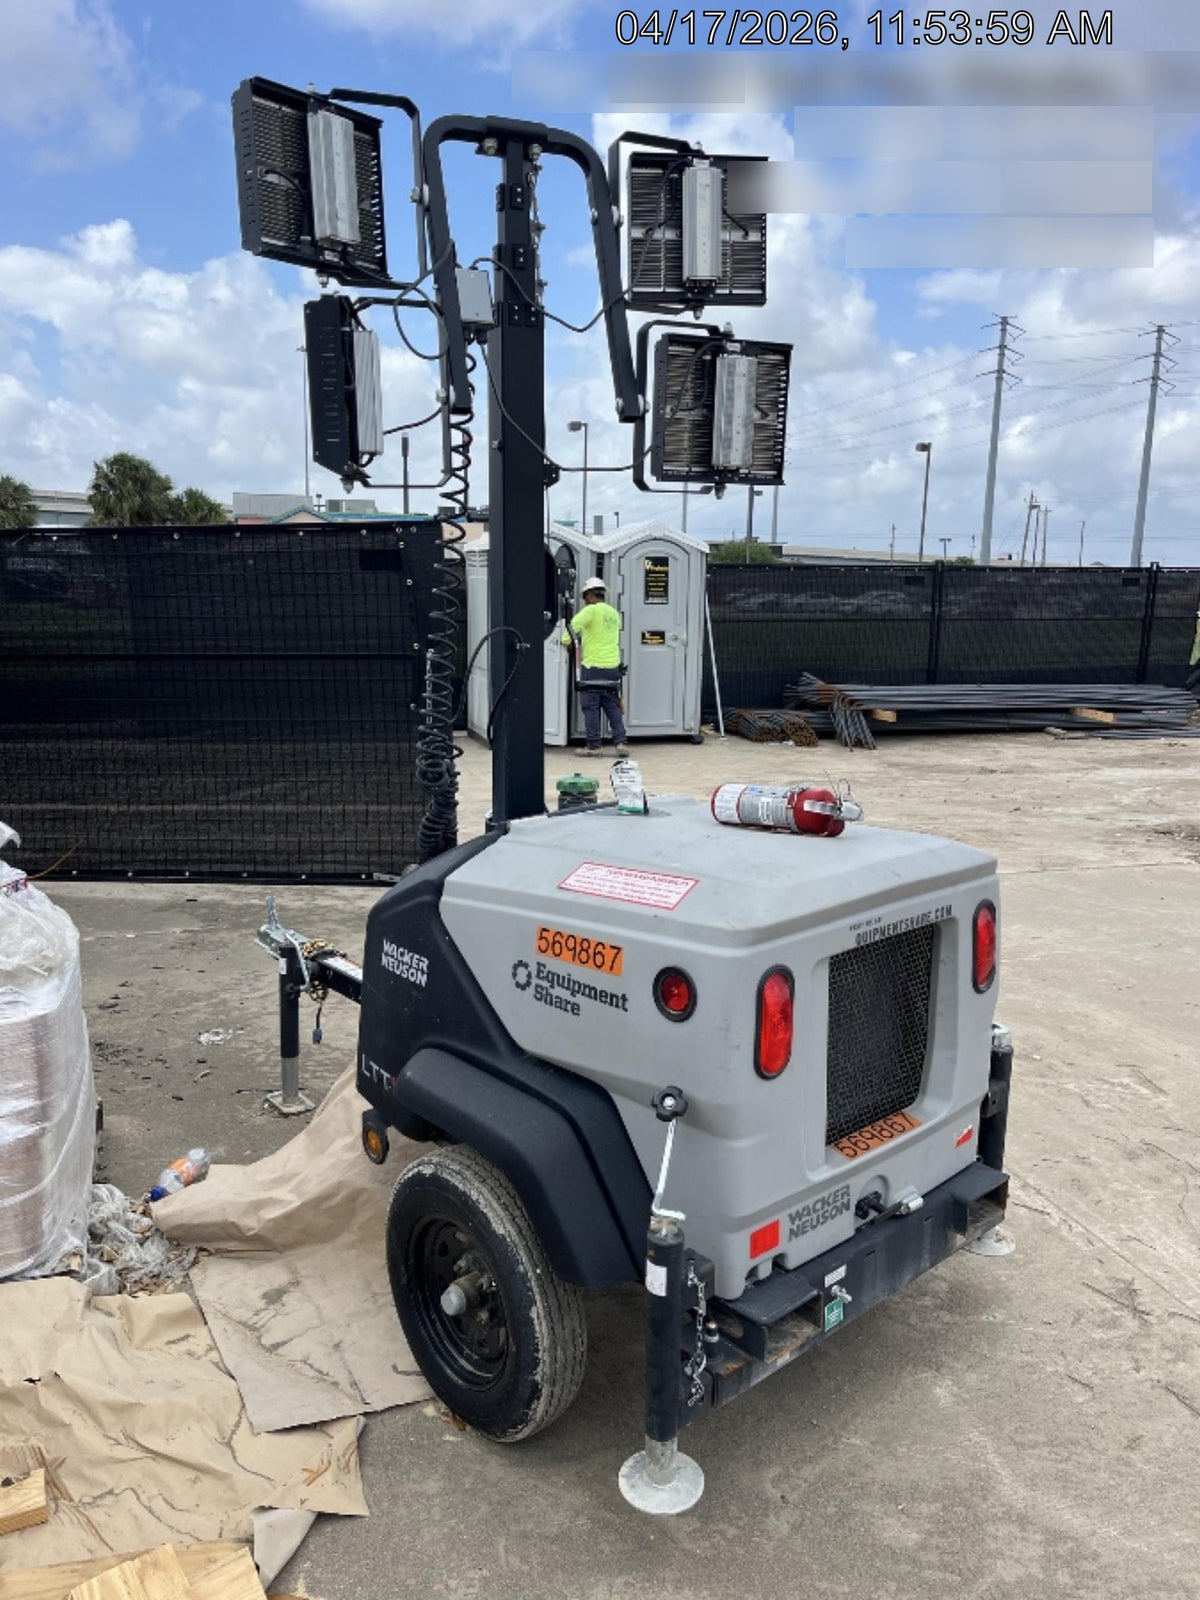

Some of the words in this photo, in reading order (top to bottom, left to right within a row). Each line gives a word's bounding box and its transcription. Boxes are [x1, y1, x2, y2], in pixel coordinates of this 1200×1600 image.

[381, 952, 428, 988] NEUSON
[383, 939, 429, 973] WACKER
[537, 927, 623, 972] 569867
[533, 983, 581, 1016] Share
[535, 961, 629, 1013] Equipment
[834, 1112, 915, 1158] 569867
[788, 1183, 851, 1226] WACKER
[788, 1197, 851, 1243] NEUSON
